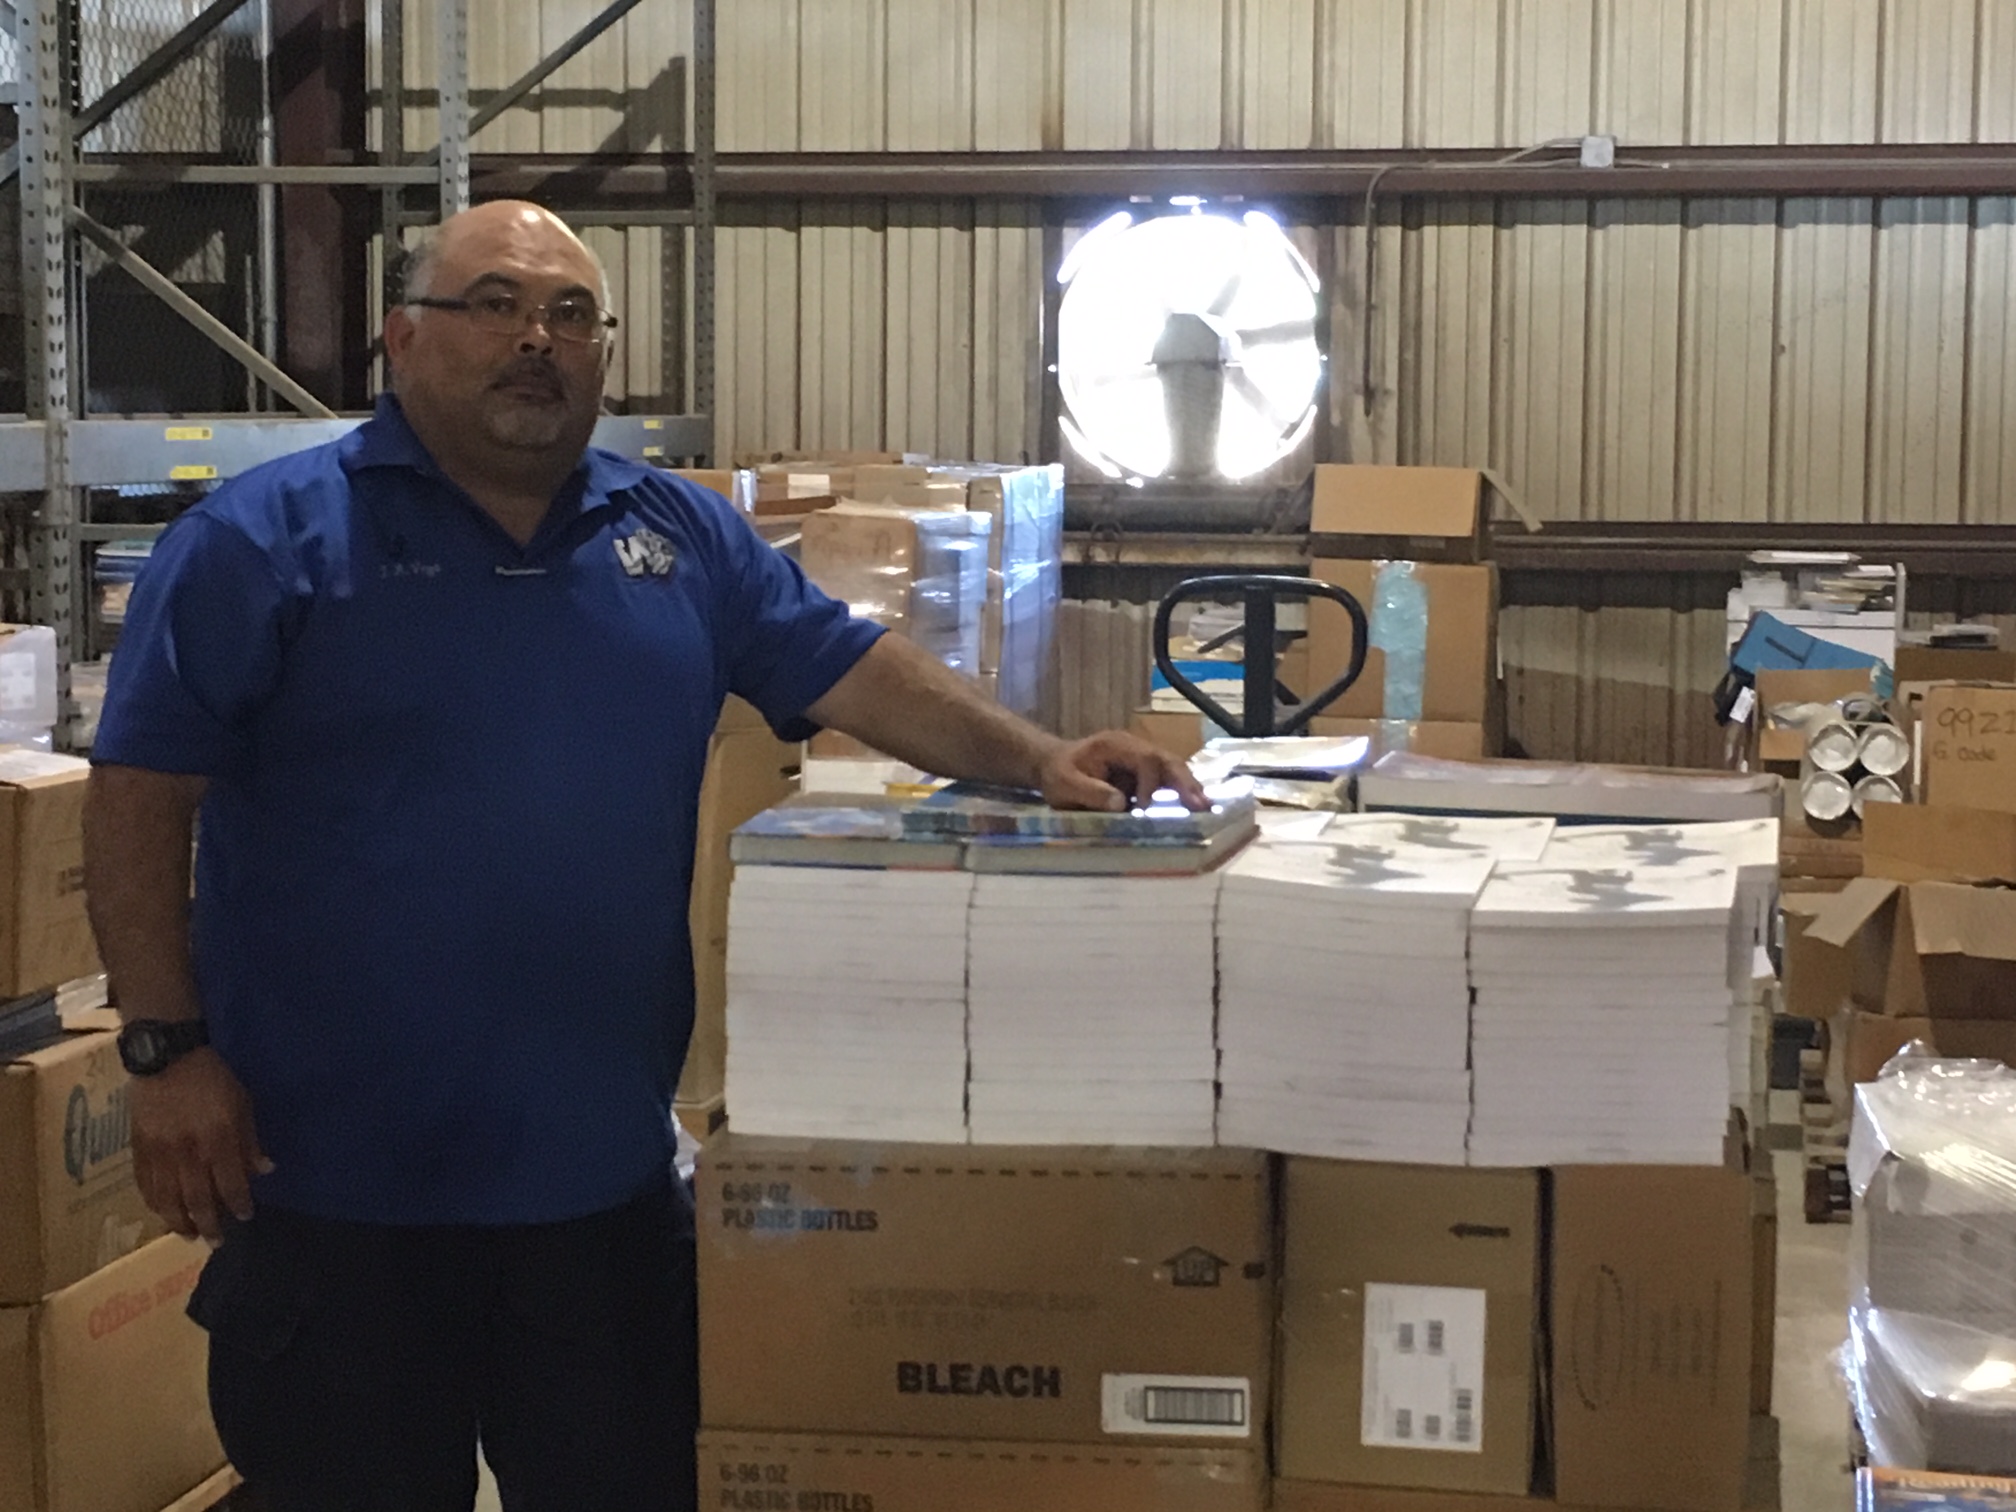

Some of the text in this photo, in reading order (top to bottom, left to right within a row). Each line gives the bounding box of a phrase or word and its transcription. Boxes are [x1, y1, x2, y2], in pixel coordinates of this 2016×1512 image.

[722, 1208, 879, 1232] PLASTIC BOTTLES
[897, 1361, 1061, 1398] BLEACH
[720, 1488, 874, 1512] PLASTIC BOTTLES
